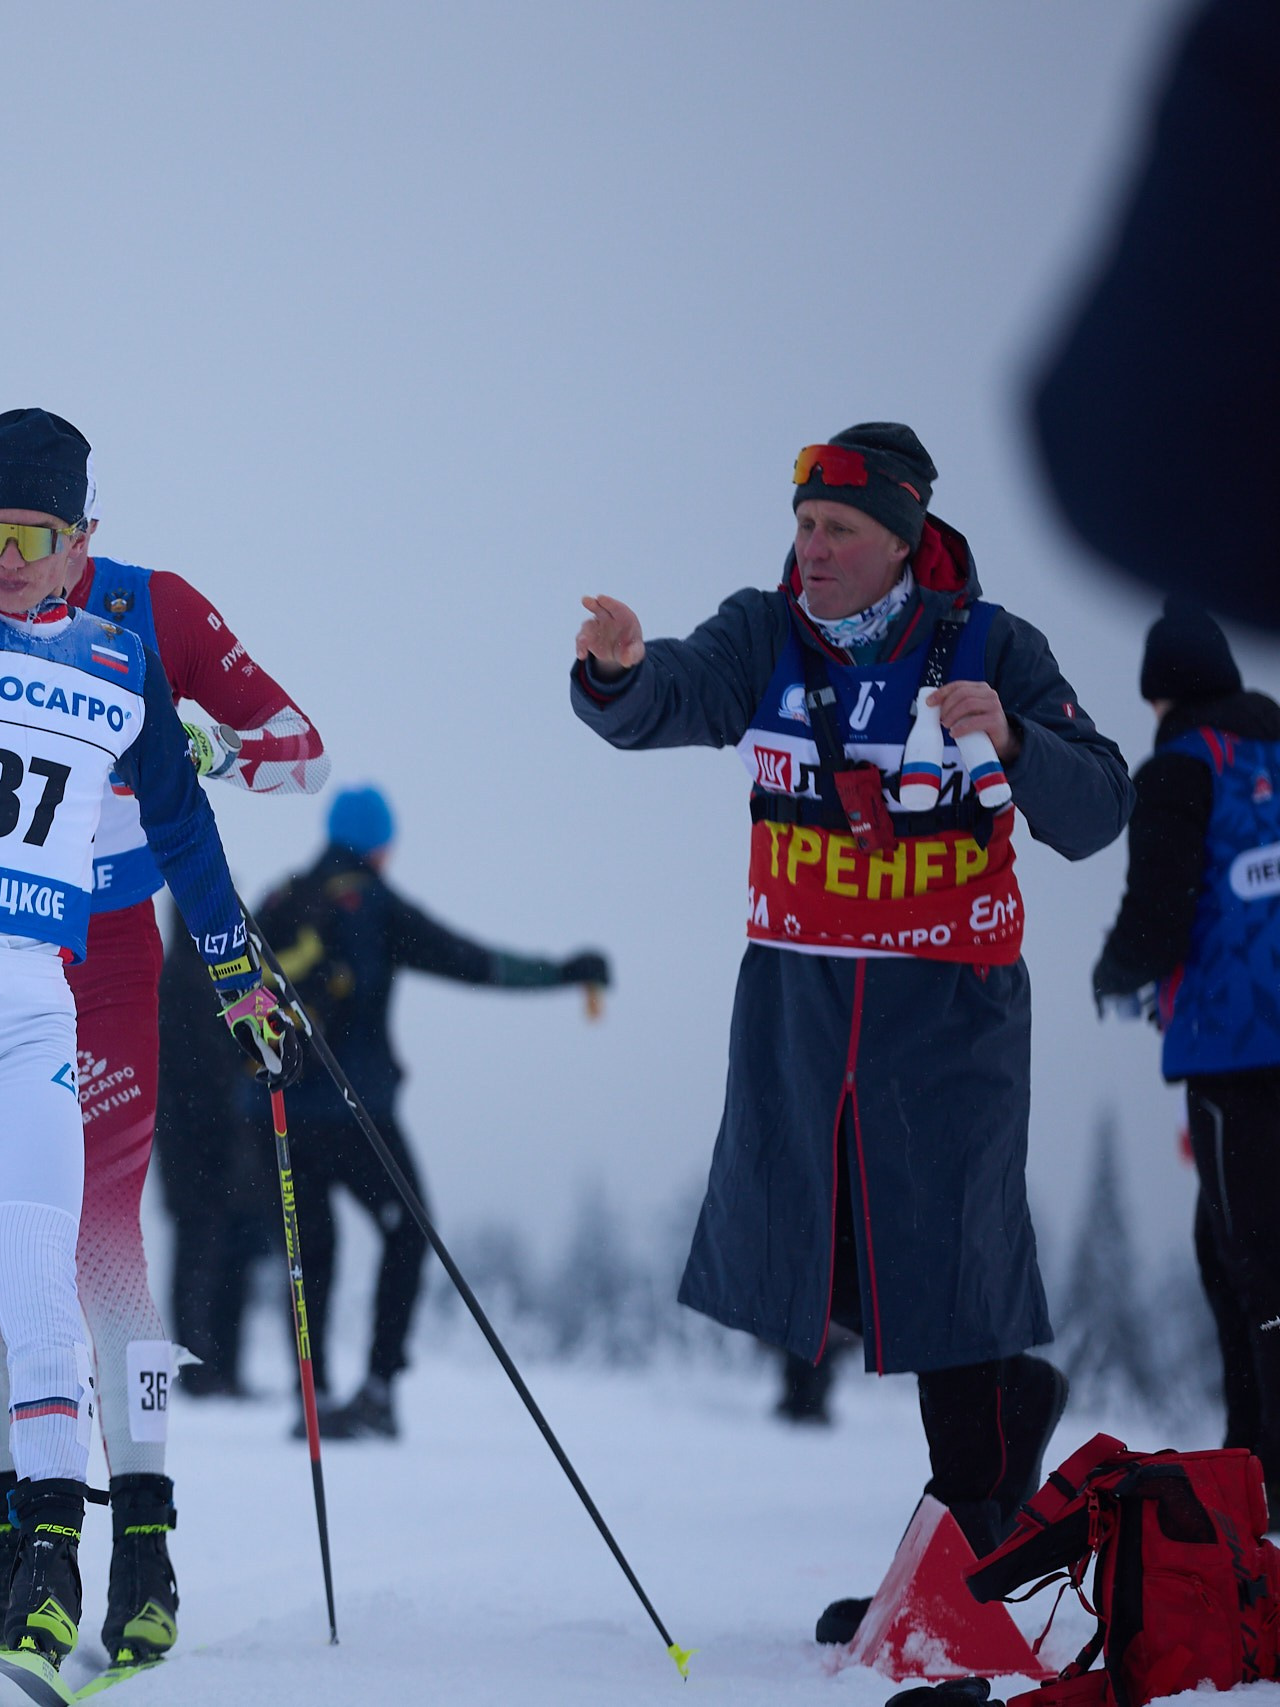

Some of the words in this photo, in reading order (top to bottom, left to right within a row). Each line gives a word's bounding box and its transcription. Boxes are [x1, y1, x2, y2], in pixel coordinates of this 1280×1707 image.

[764, 819, 989, 900] ТРЕНЕР
[79, 1066, 135, 1103] ОСАГРО
[140, 1371, 168, 1411] 36
